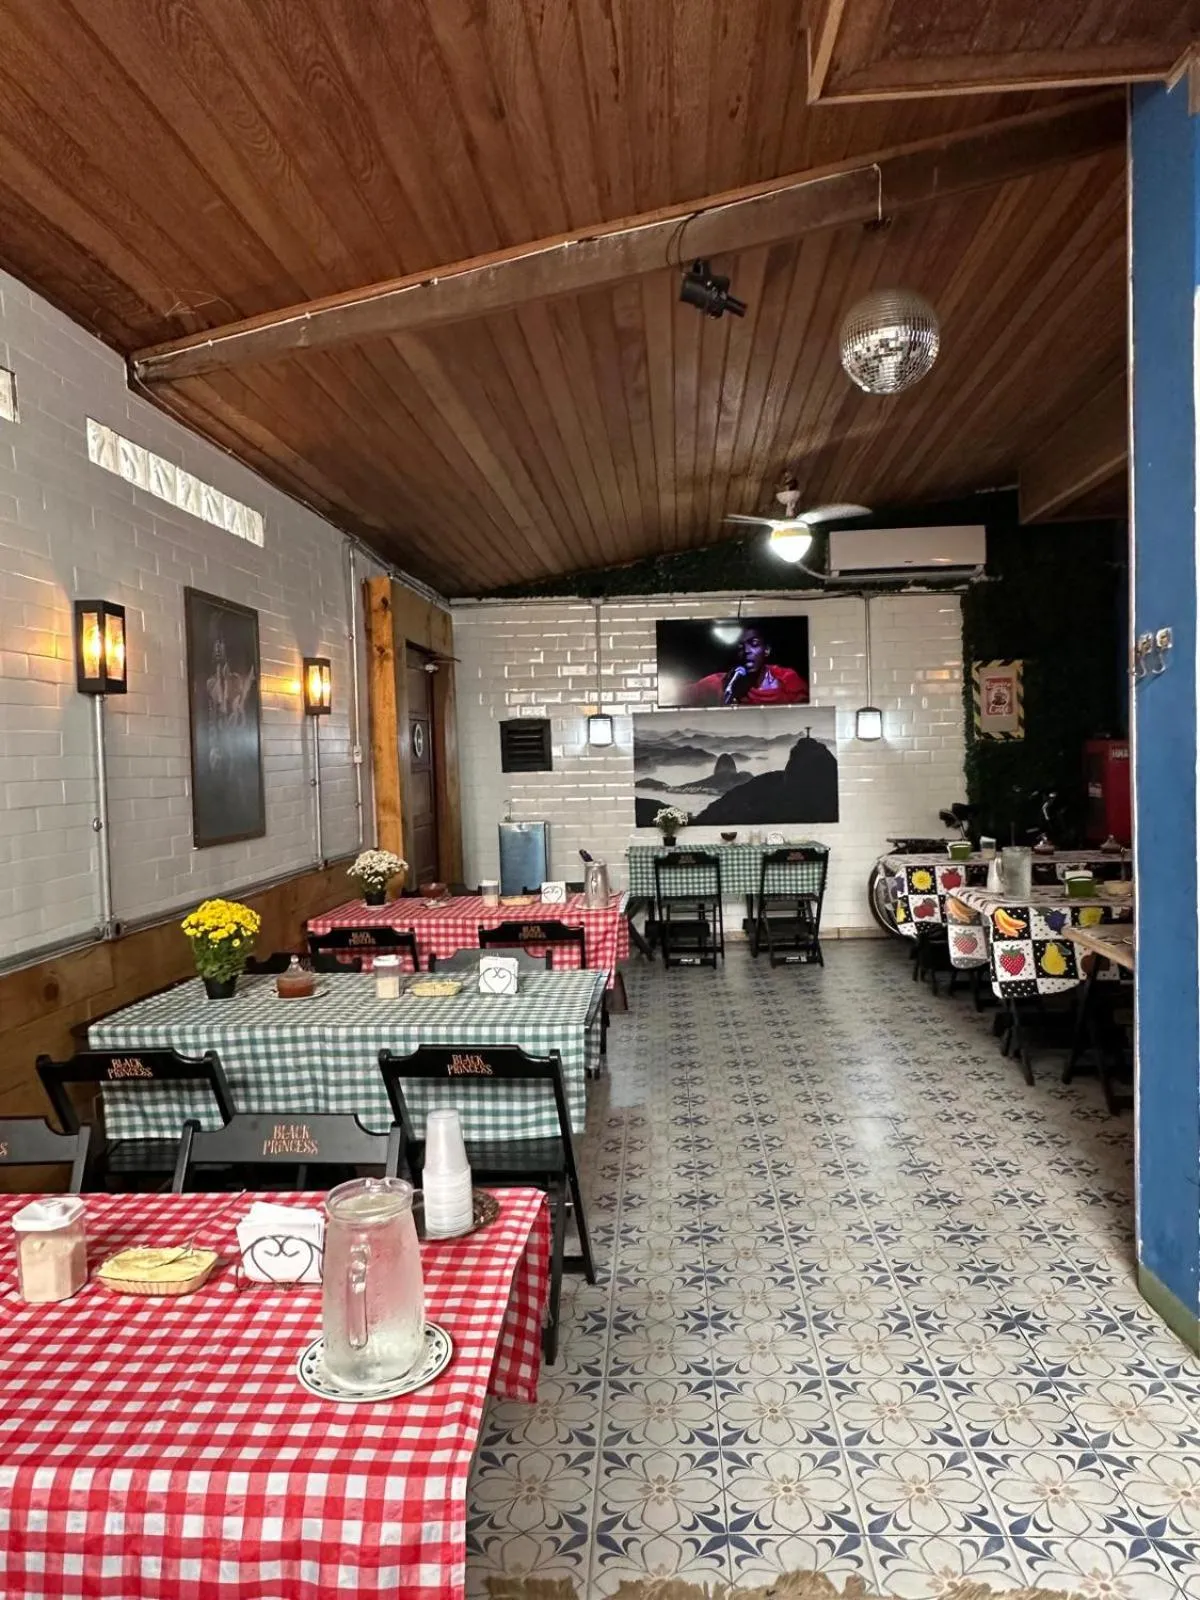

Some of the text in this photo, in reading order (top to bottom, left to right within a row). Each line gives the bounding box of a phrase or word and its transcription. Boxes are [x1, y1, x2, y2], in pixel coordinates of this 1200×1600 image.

[111, 1058, 144, 1070] BLACK
[451, 1054, 484, 1066] BLACK
[107, 1067, 154, 1080] PRINCESS
[447, 1063, 493, 1076] PRINCESS
[273, 1124, 309, 1140] BLACK
[262, 1139, 319, 1155] PRINCESS
